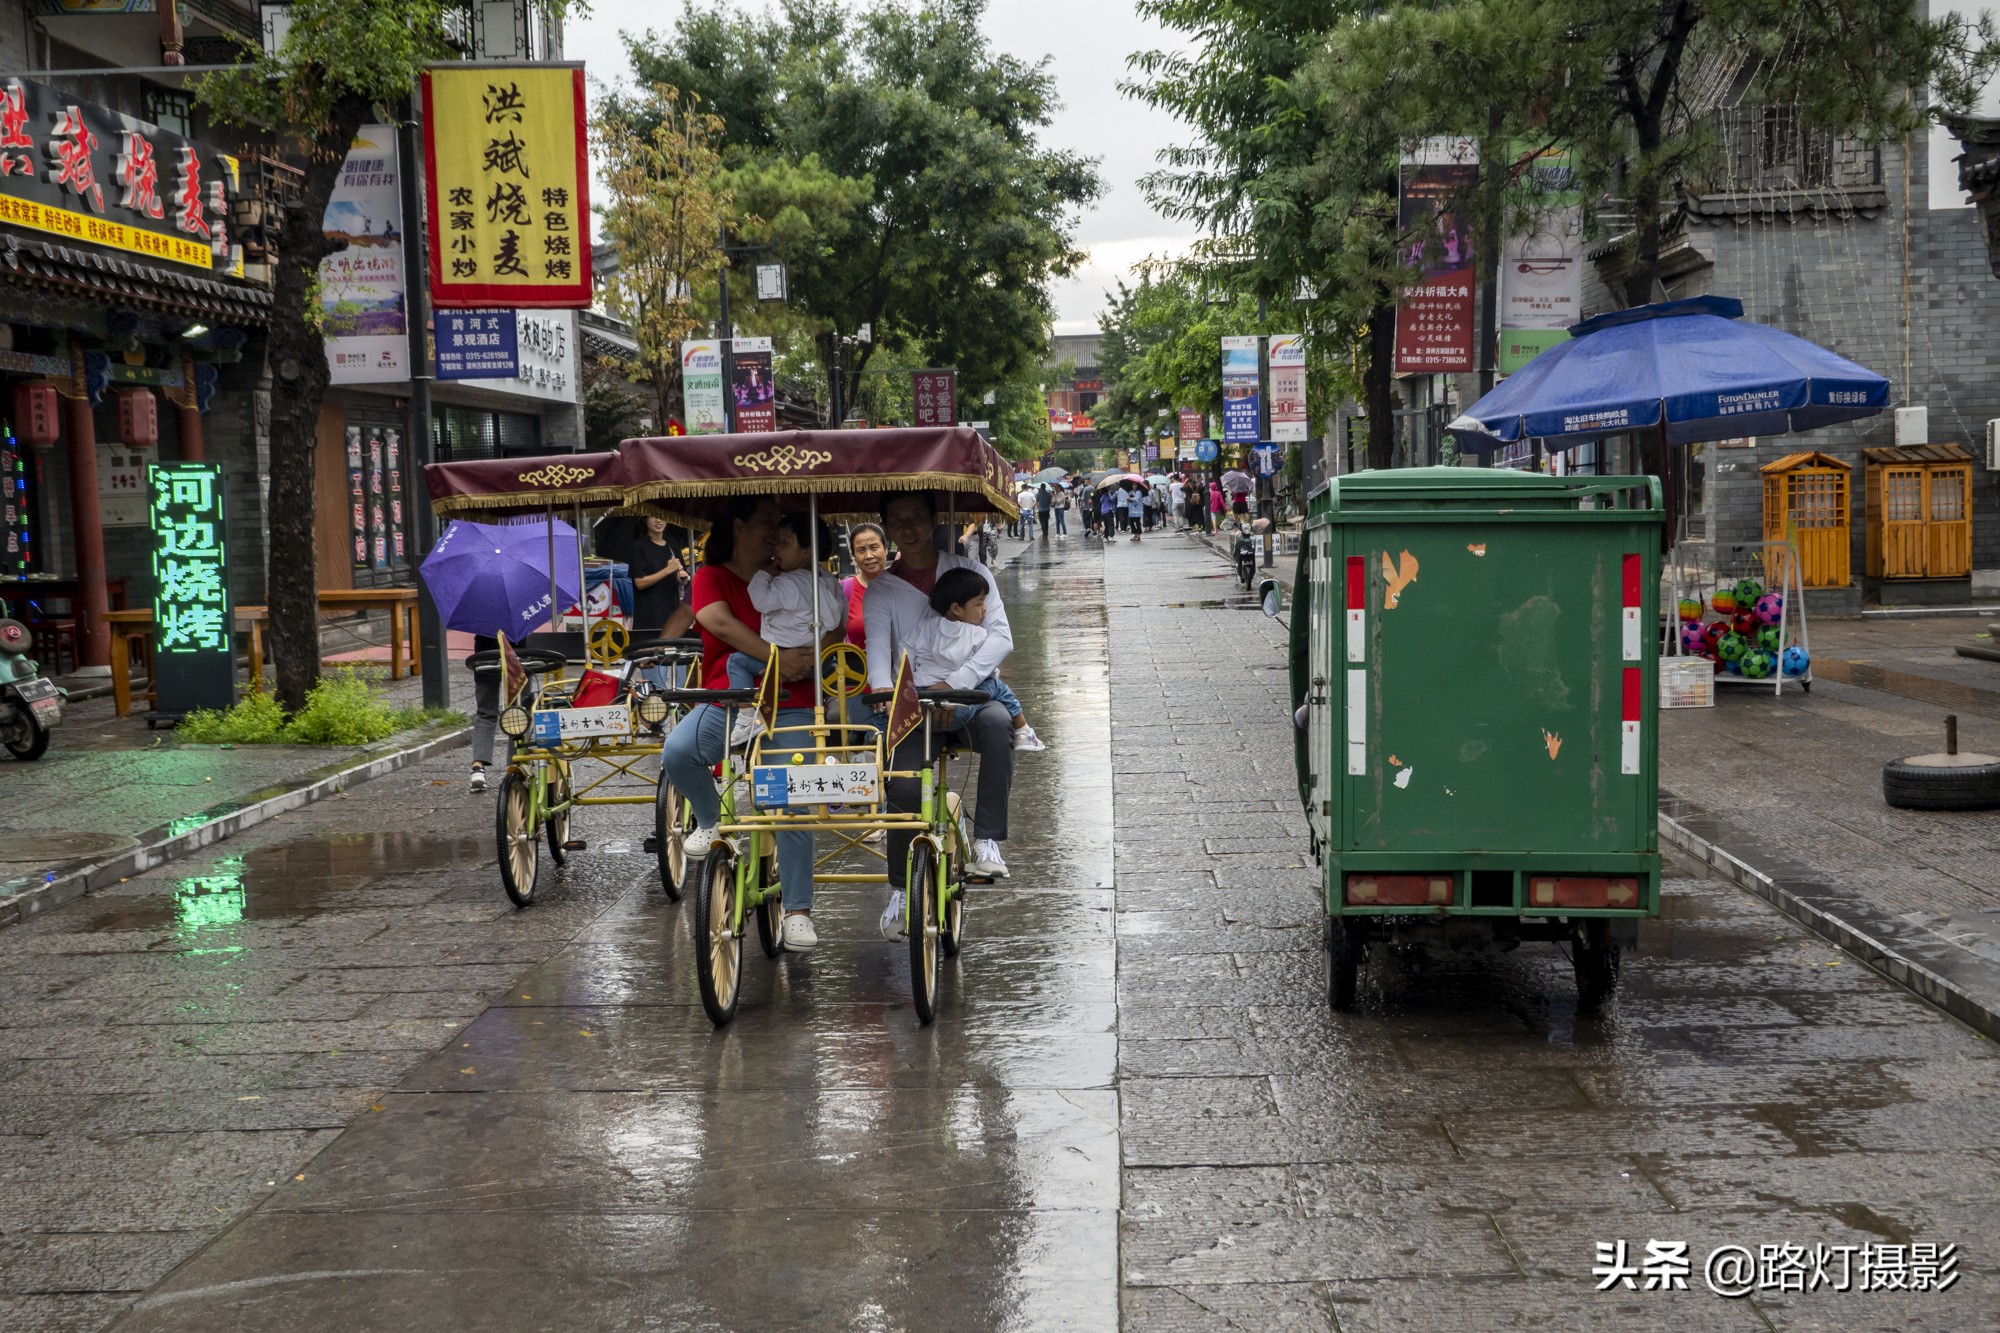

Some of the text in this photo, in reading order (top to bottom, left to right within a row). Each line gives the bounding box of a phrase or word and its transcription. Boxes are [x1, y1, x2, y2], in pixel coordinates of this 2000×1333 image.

[482, 81, 532, 278] 洪斌烧麦
[448, 187, 478, 278] 农家小炒
[542, 187, 572, 280] 特色烧烤
[452, 333, 501, 347] 景观酒店
[918, 376, 934, 423] 冷饮吧
[936, 376, 951, 423] 可爱雪
[1564, 409, 1629, 425] 淘汰旧车换购欧曼
[1828, 391, 1868, 404] 黄标换绿标
[155, 470, 223, 649] 河边烧烤
[608, 710, 621, 720] 22
[850, 770, 867, 782] 32
